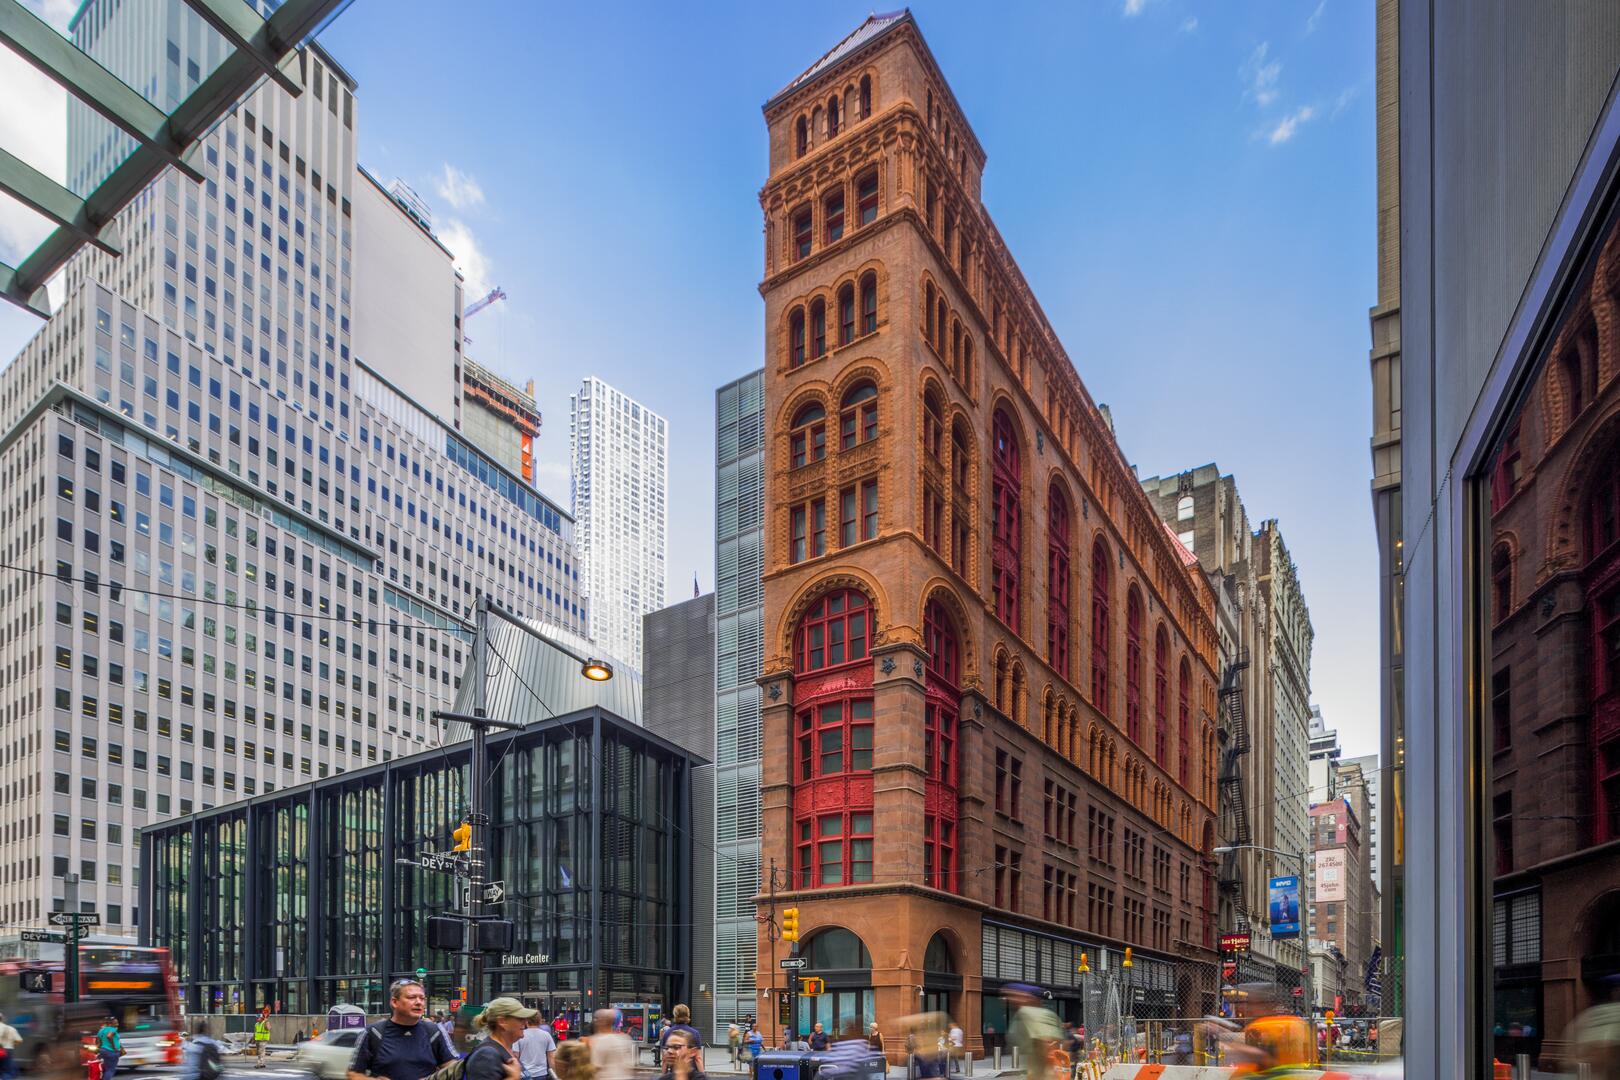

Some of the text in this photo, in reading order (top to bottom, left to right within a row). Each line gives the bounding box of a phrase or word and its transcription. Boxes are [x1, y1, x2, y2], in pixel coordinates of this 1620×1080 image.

[421, 856, 453, 870] DEY ST
[486, 888, 499, 898] WAY
[525, 953, 549, 964] Center
